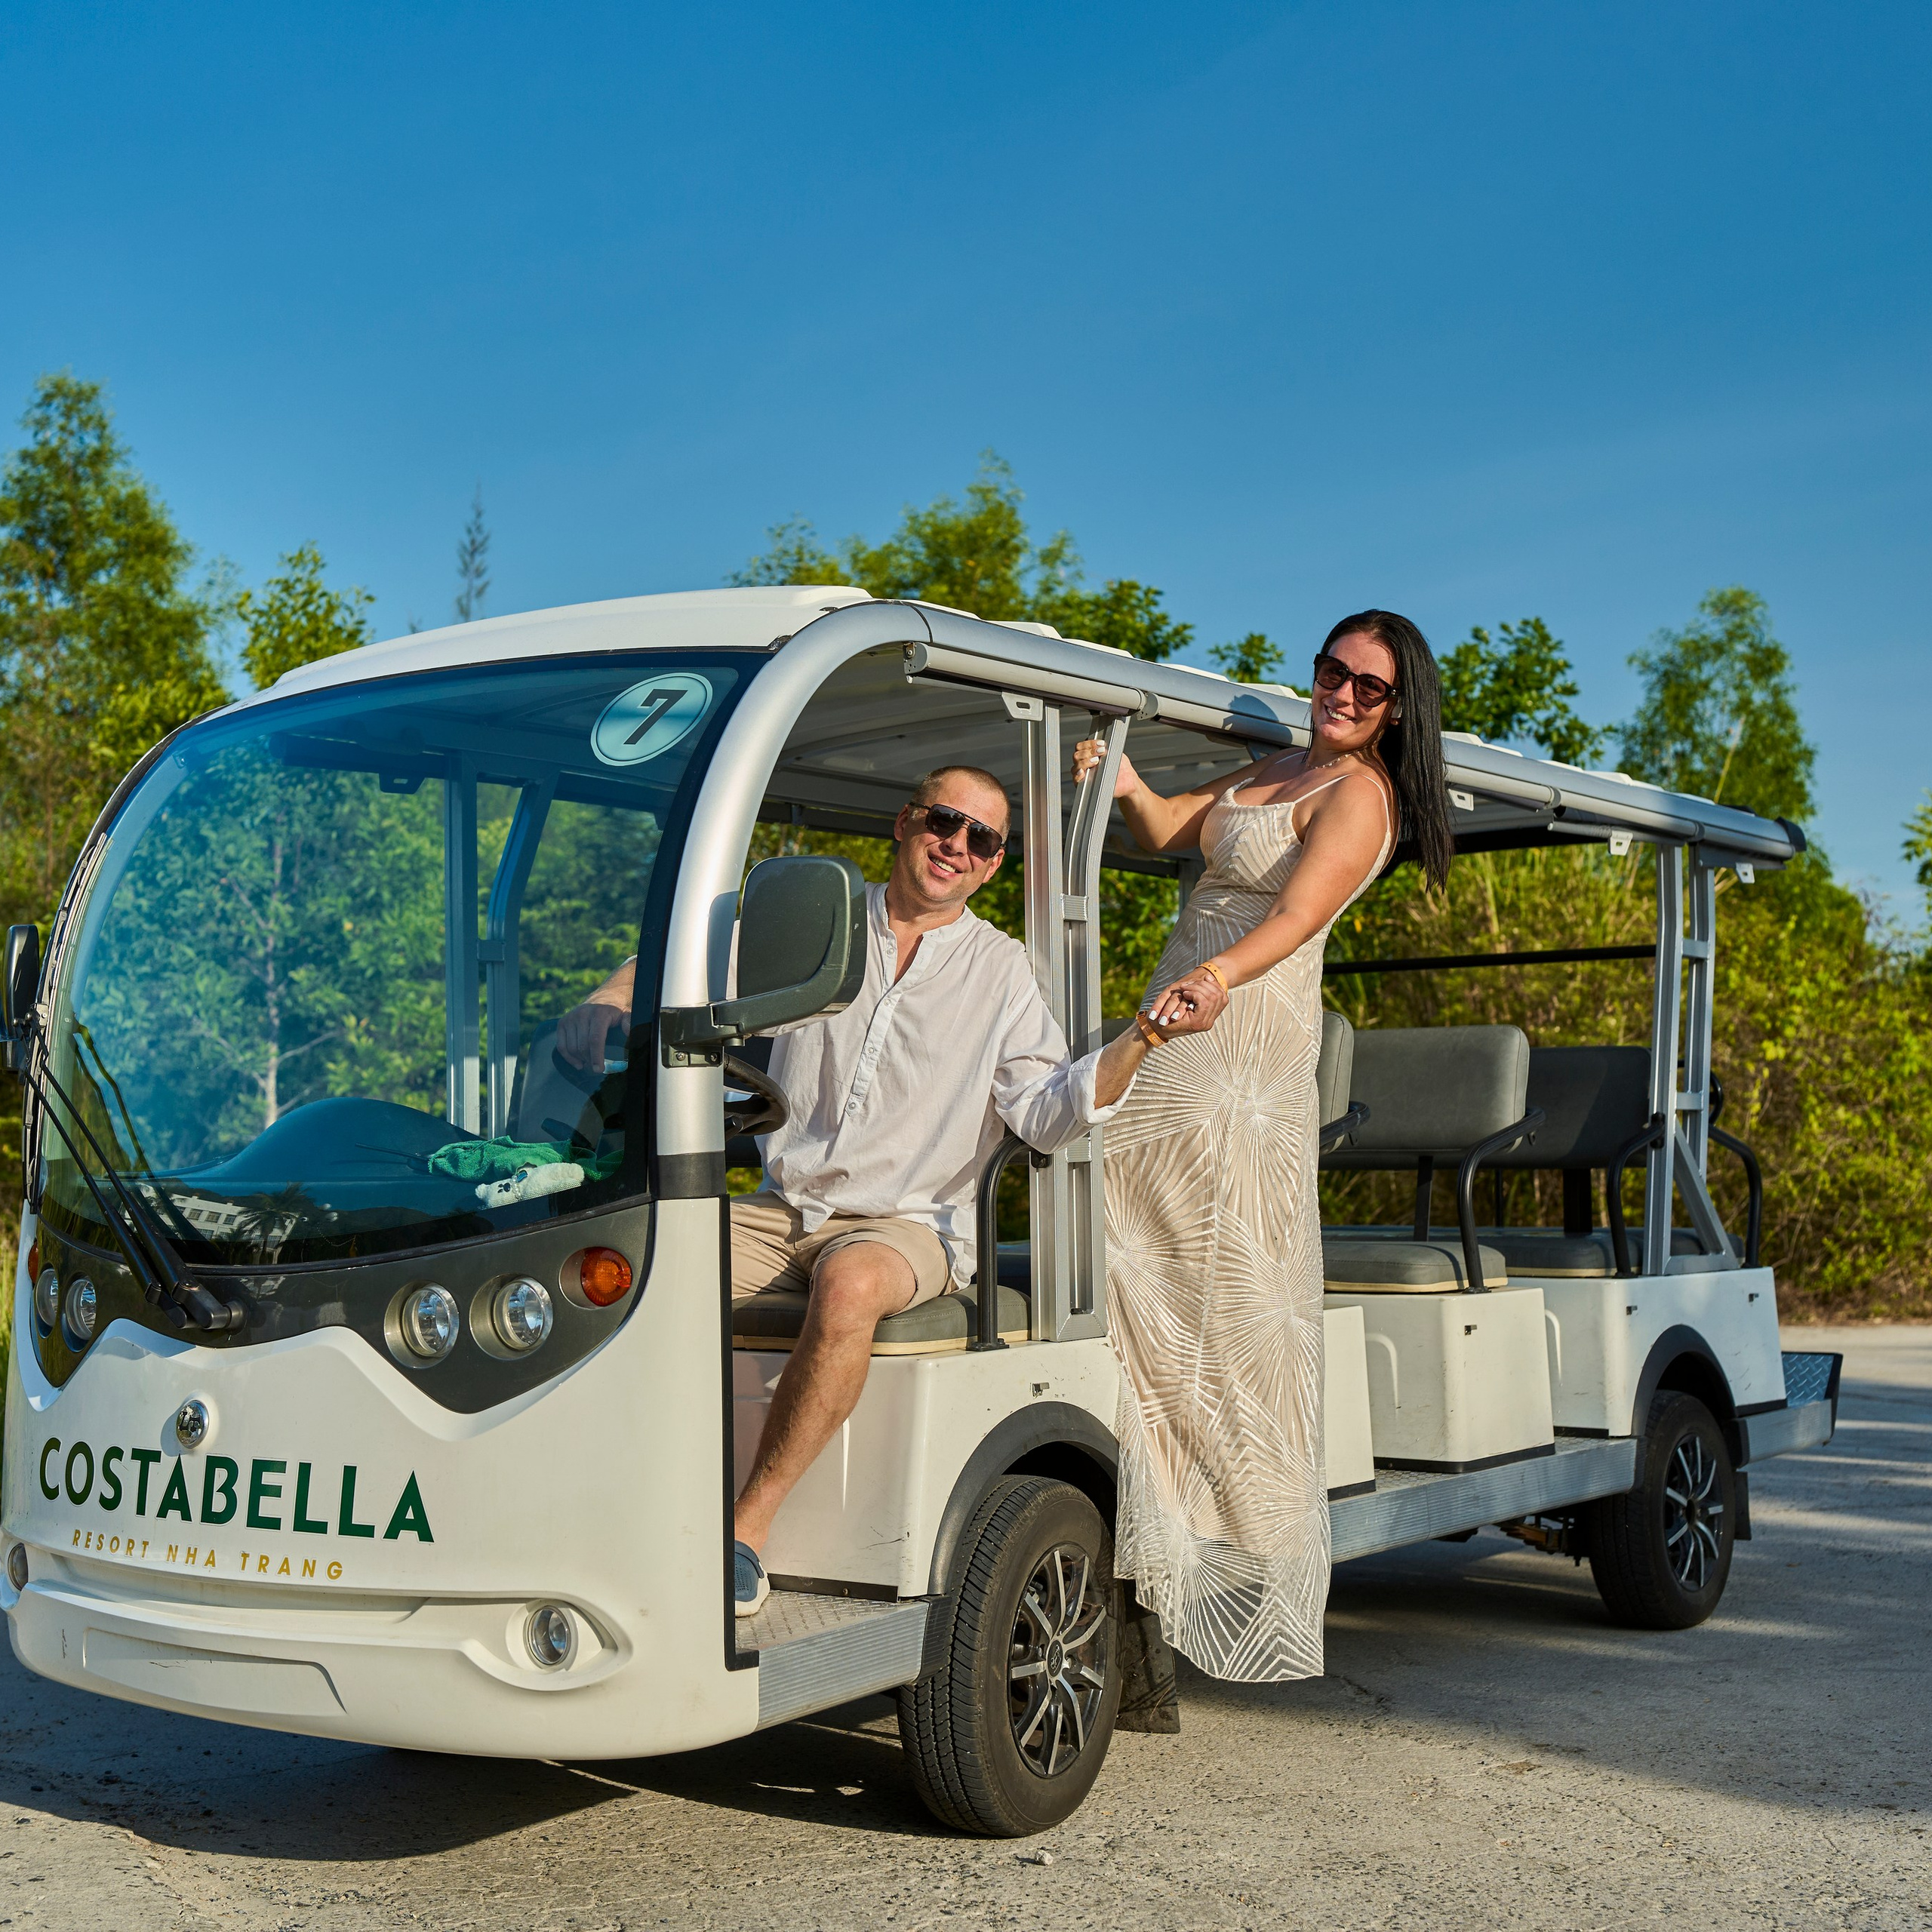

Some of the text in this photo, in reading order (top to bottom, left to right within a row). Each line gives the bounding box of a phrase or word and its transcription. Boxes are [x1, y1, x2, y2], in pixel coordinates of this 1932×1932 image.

[623, 688, 688, 745] 7
[39, 1437, 435, 1543] COSTABELLA
[73, 1529, 343, 1580] RESORT NHA TRANG
